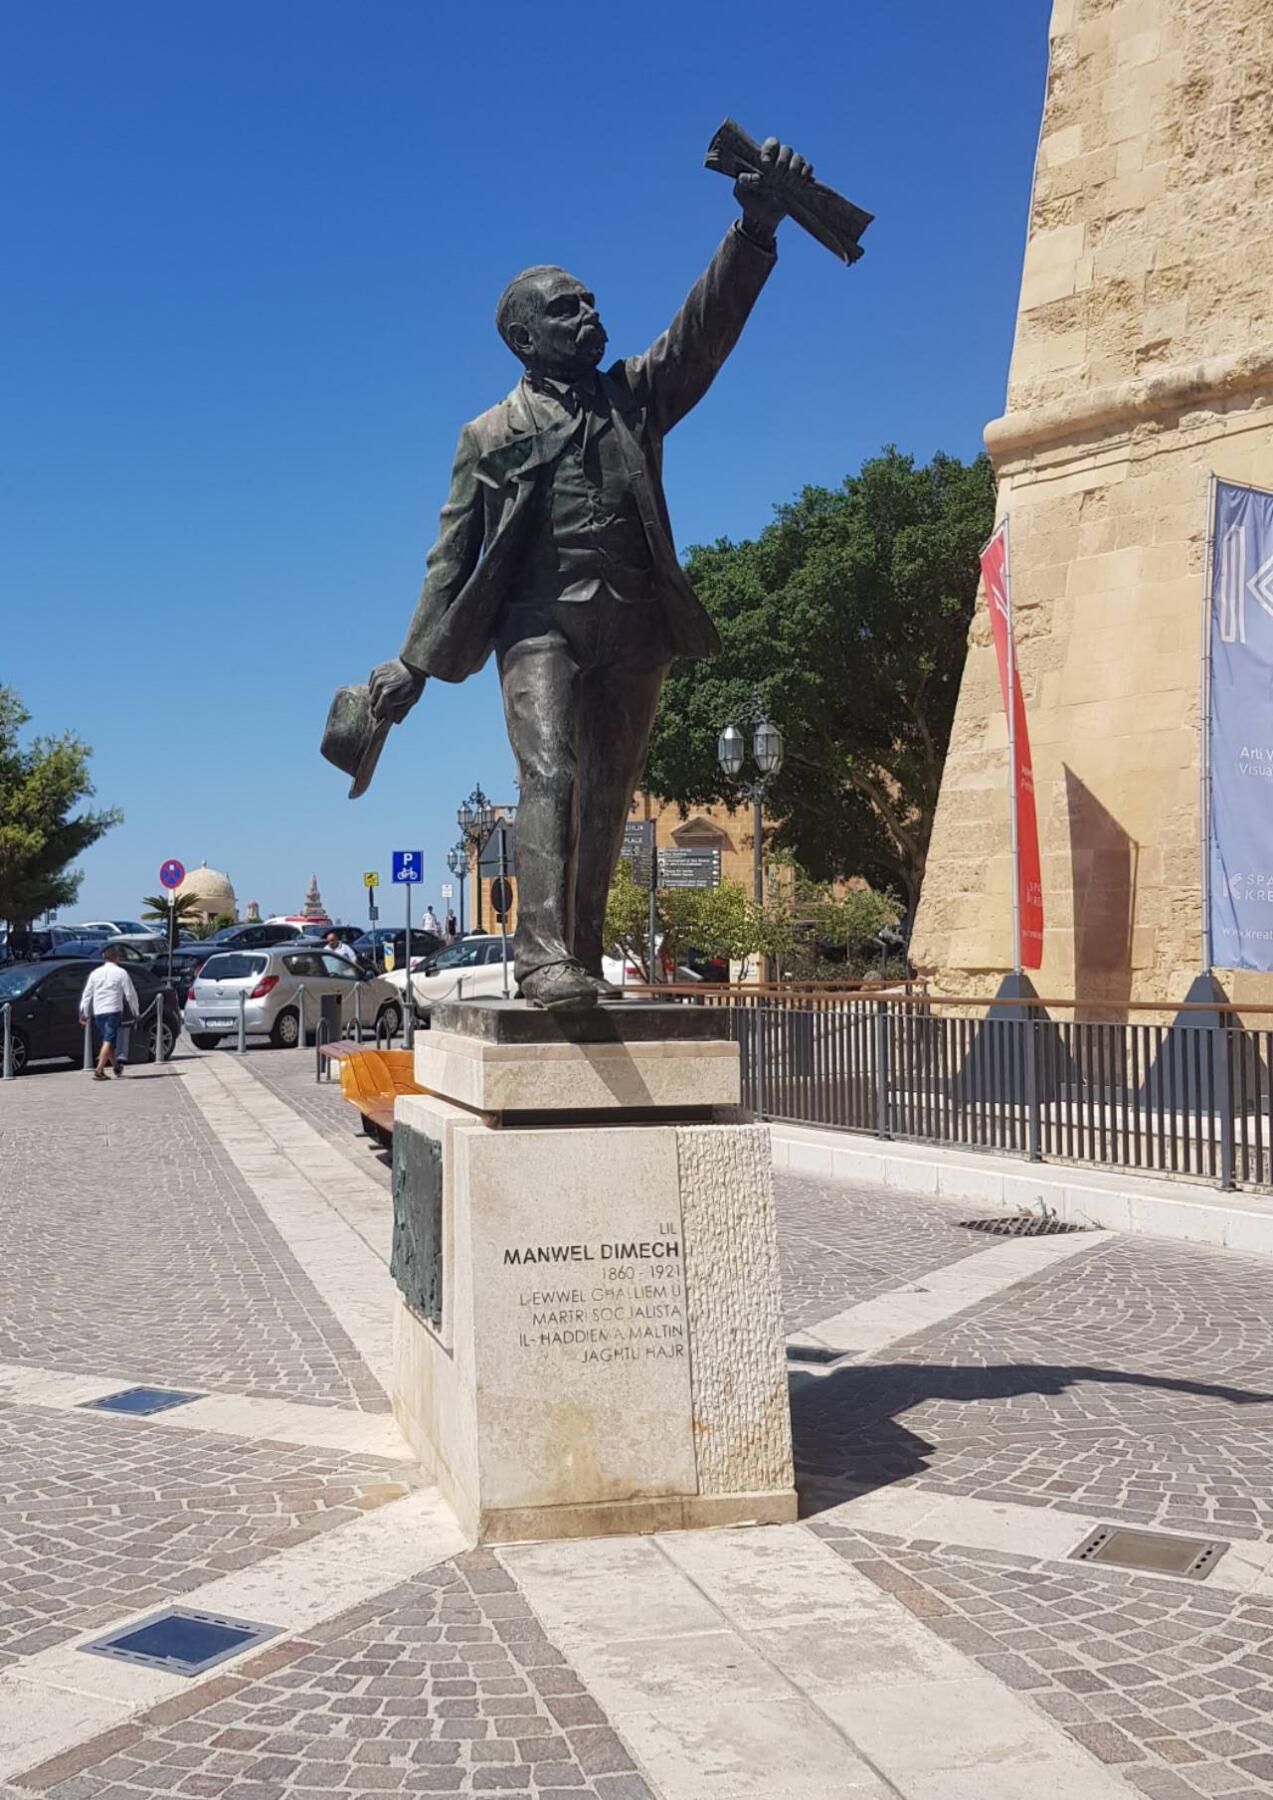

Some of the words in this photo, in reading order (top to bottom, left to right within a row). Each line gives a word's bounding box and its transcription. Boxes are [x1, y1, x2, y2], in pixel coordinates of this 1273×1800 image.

[404, 853, 413, 866] P
[659, 1222, 677, 1235] LIL
[504, 1246, 594, 1264] MANWEL
[600, 1242, 679, 1260] DIMECH
[602, 1266, 634, 1280] 1860
[650, 1264, 680, 1278] 1921
[672, 1285, 681, 1296] U
[532, 1309, 587, 1325] MARTRI
[630, 1324, 682, 1339] MALTIN
